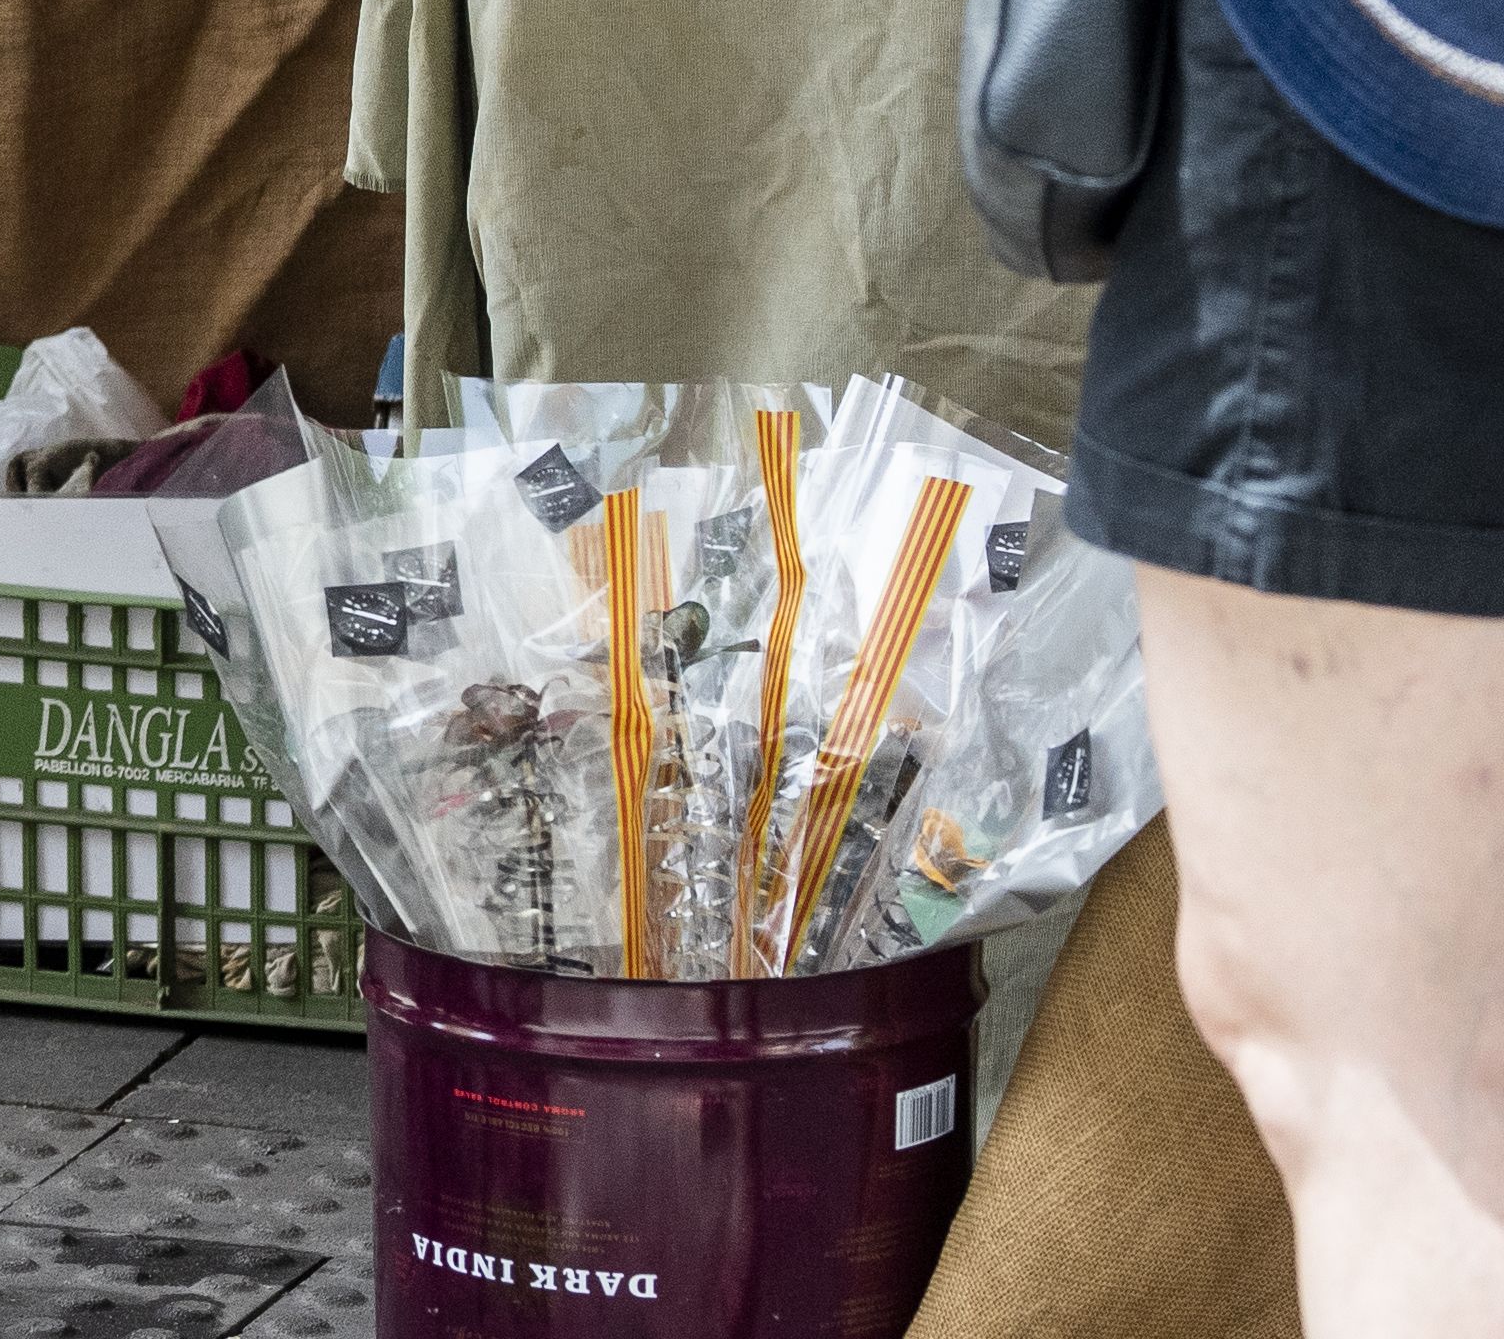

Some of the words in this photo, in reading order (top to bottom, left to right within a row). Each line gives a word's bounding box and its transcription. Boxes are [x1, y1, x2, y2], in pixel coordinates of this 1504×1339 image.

[34, 697, 232, 772] DANGLA
[34, 758, 101, 777] PABELLON
[155, 769, 246, 789] MERCABARNA
[488, 1096, 539, 1112] CONTROL
[412, 1232, 514, 1285] INDIA
[529, 1263, 659, 1299] DARK
